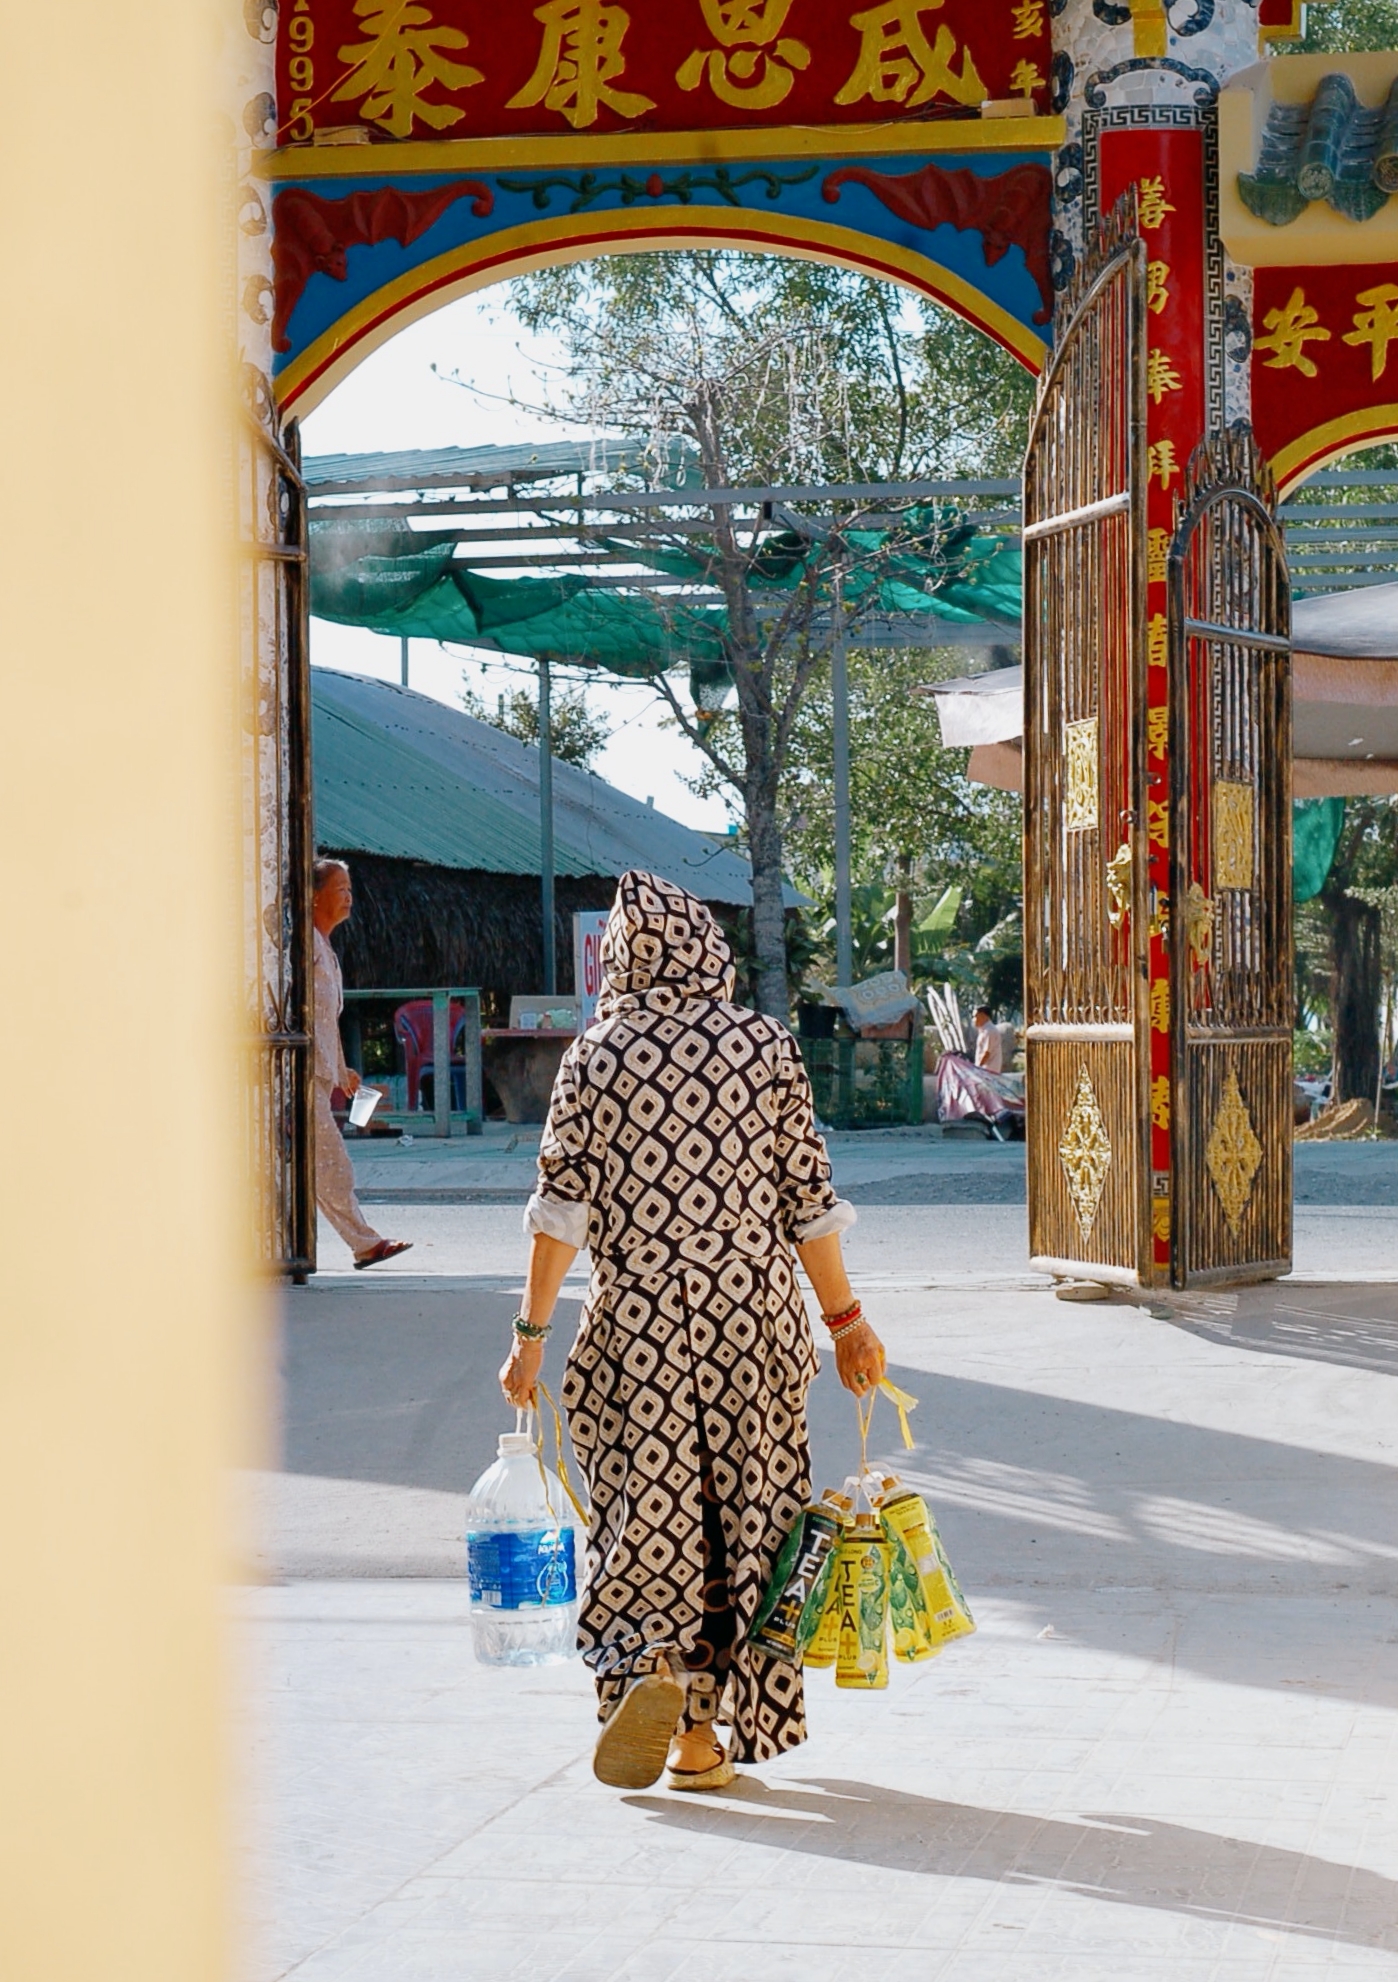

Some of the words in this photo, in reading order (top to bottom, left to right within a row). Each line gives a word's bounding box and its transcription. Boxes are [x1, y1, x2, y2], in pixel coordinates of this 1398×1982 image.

[288, 0, 315, 141] 995
[784, 1528, 831, 1604] TEA
[840, 1560, 857, 1633] TEA
[773, 1615, 796, 1630] PLUS
